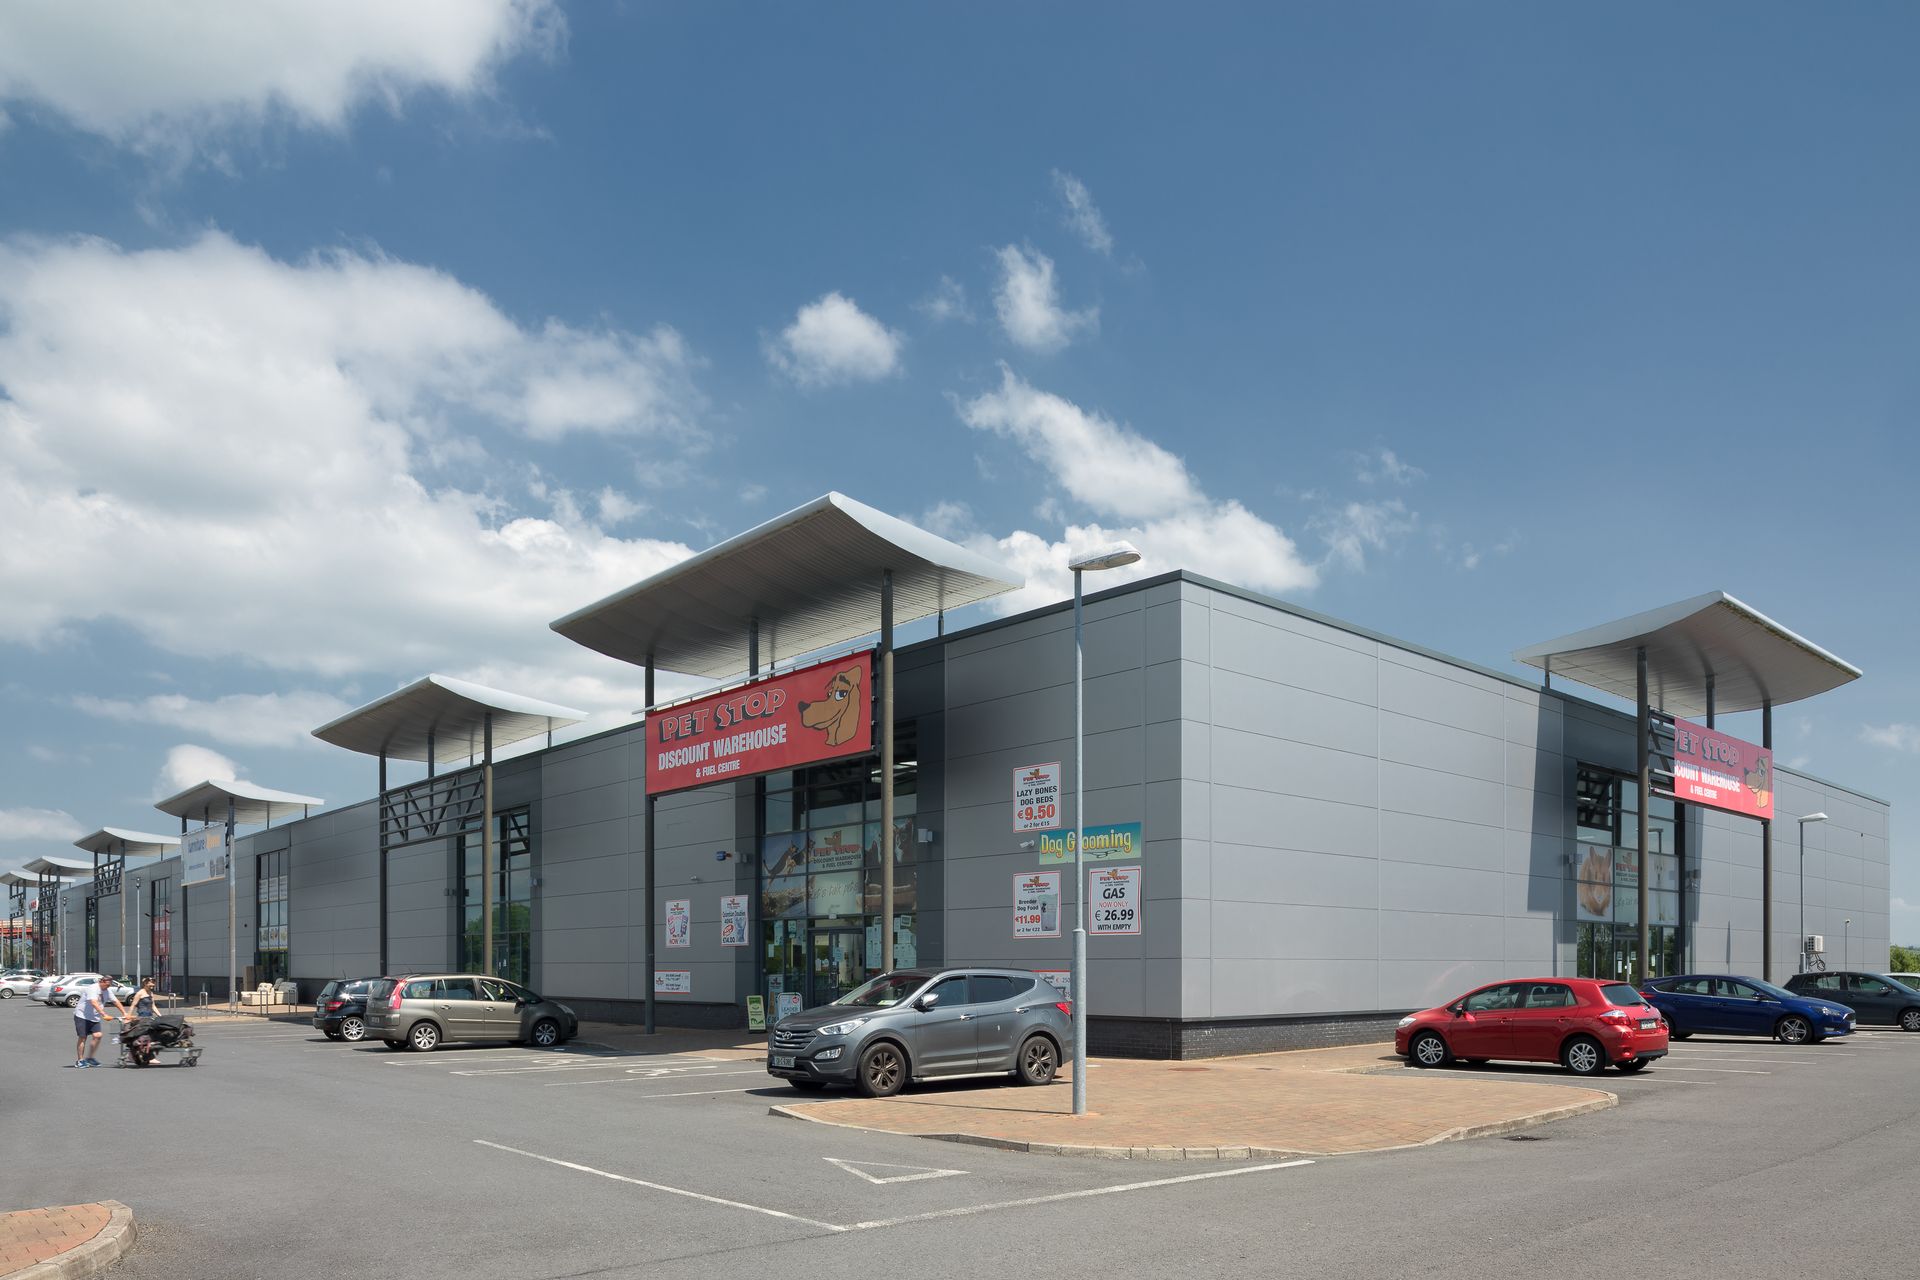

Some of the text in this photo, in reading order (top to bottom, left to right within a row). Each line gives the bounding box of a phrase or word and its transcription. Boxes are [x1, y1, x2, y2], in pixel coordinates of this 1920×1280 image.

[660, 688, 787, 743] PET STOP
[658, 723, 787, 771] DISCOUNT WAREHOUSE
[1702, 736, 1739, 767] STOP
[696, 760, 740, 778] & FUEL CENTRE
[1674, 760, 1740, 793] COUNT WAREHOUSE
[1016, 785, 1057, 798] LAZY BONES
[1020, 795, 1053, 806] DOG BEDS
[1041, 829, 1132, 859] Dog Gooming
[1103, 887, 1125, 899] GAS
[1104, 909, 1134, 921] 26.99
[1113, 923, 1131, 931] EMPTY
